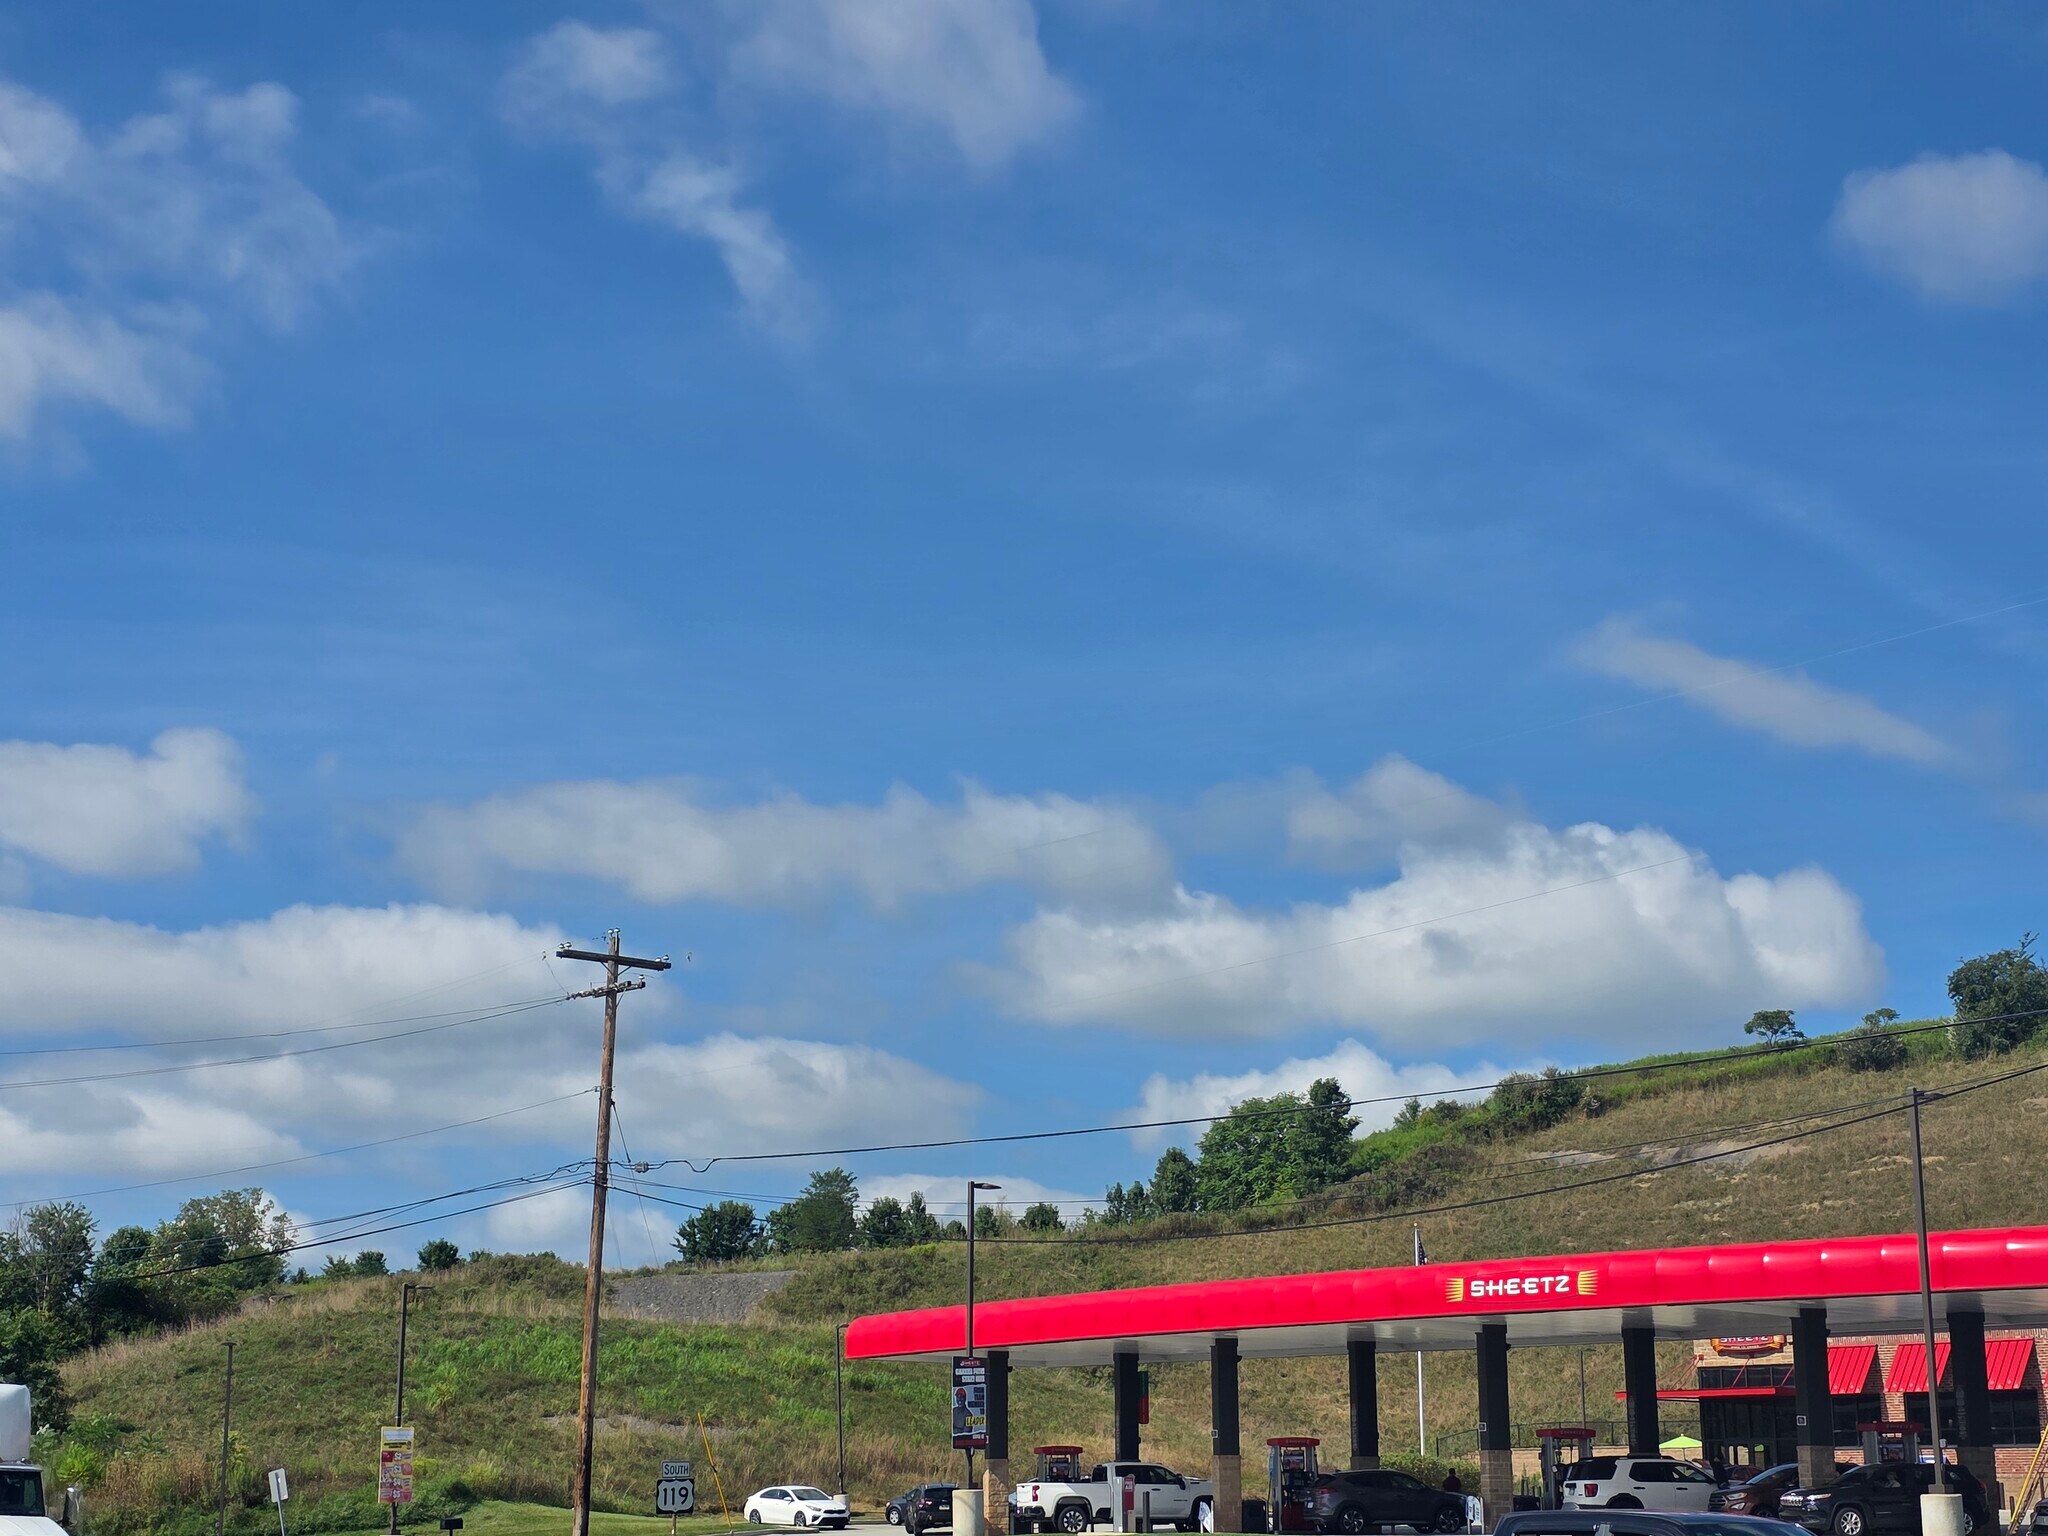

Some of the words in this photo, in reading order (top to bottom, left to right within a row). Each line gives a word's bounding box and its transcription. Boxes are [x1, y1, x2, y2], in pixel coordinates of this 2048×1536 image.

[1470, 1275, 1570, 1297] SHEETZ
[664, 1464, 689, 1475] SOUTH
[663, 1486, 689, 1506] 119
